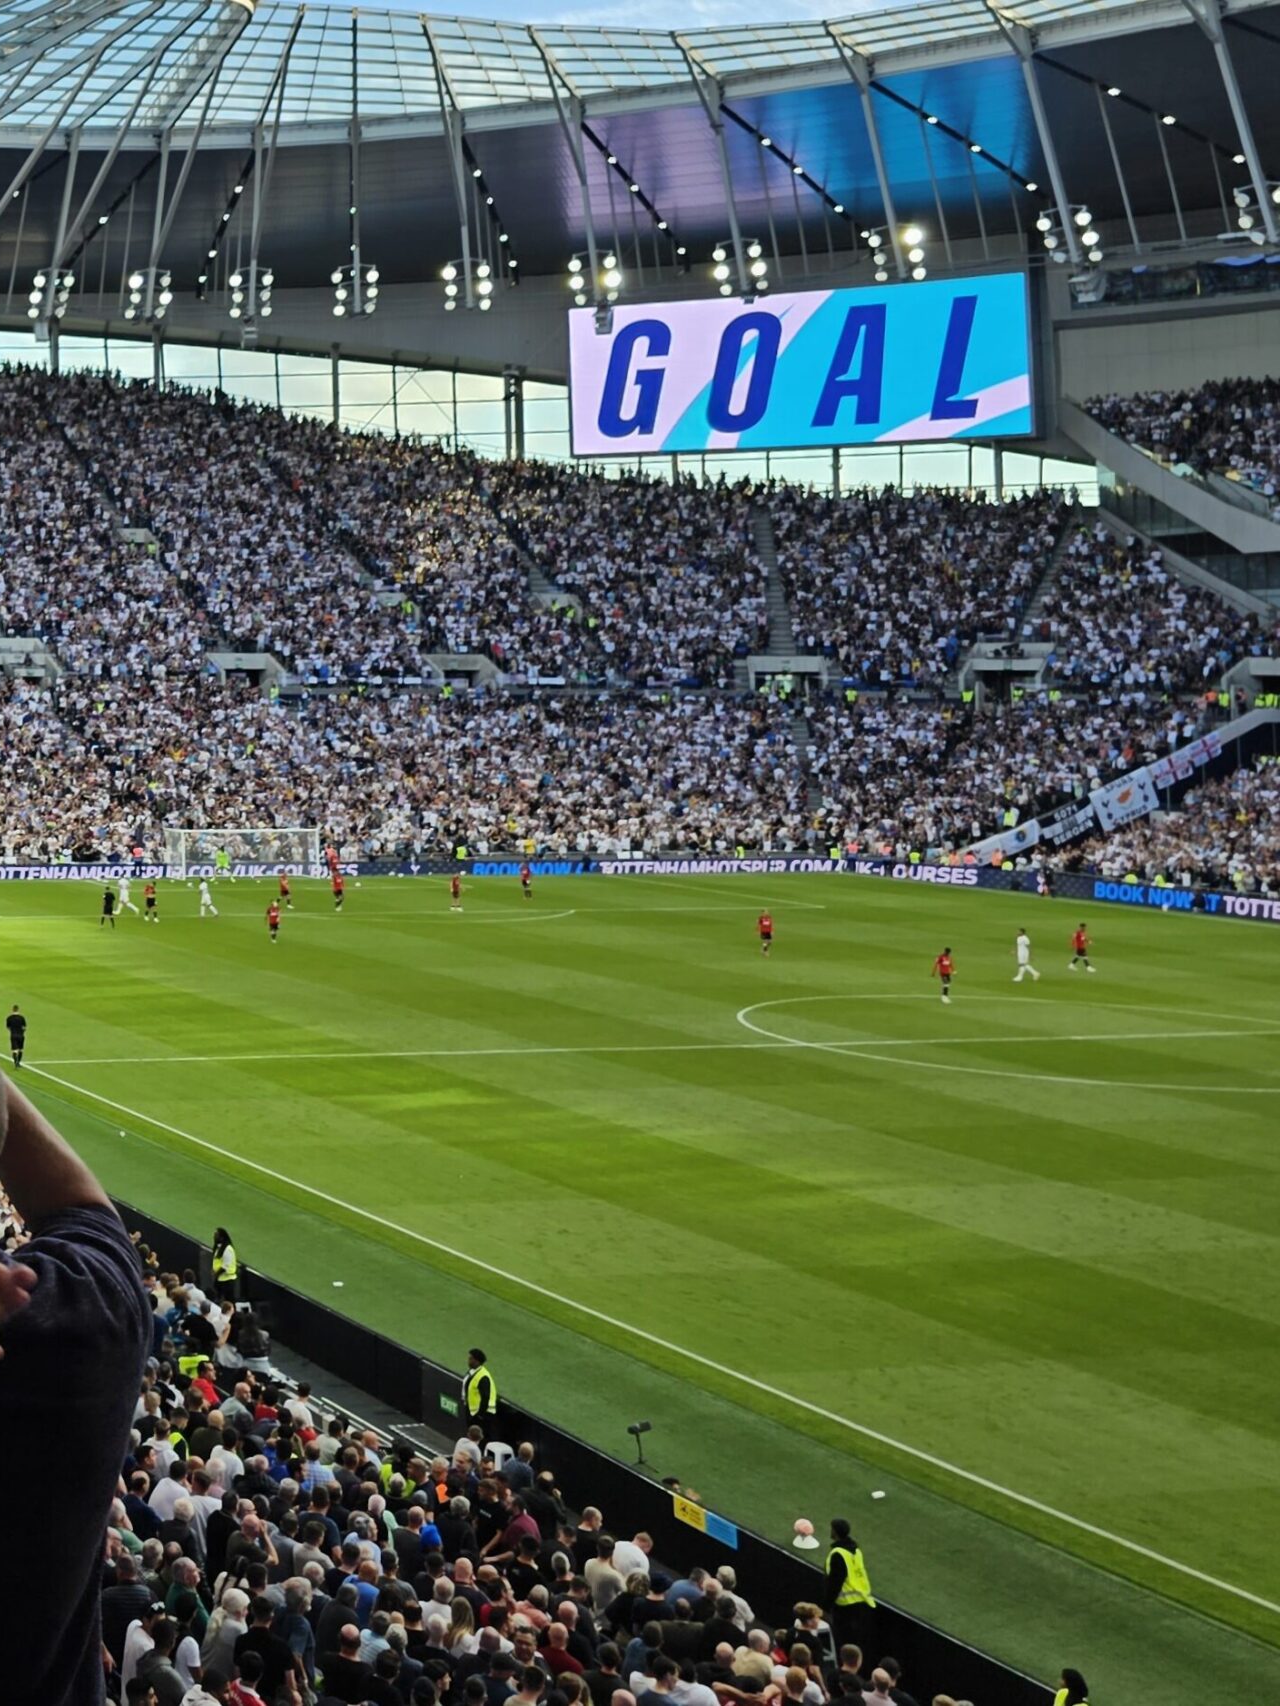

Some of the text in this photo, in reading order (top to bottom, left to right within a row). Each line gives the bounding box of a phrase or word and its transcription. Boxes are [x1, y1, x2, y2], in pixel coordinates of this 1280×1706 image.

[597, 295, 979, 438] GOAL
[528, 862, 572, 876] NOW
[1094, 881, 1144, 903] BOOK
[1148, 887, 1195, 910] NOW
